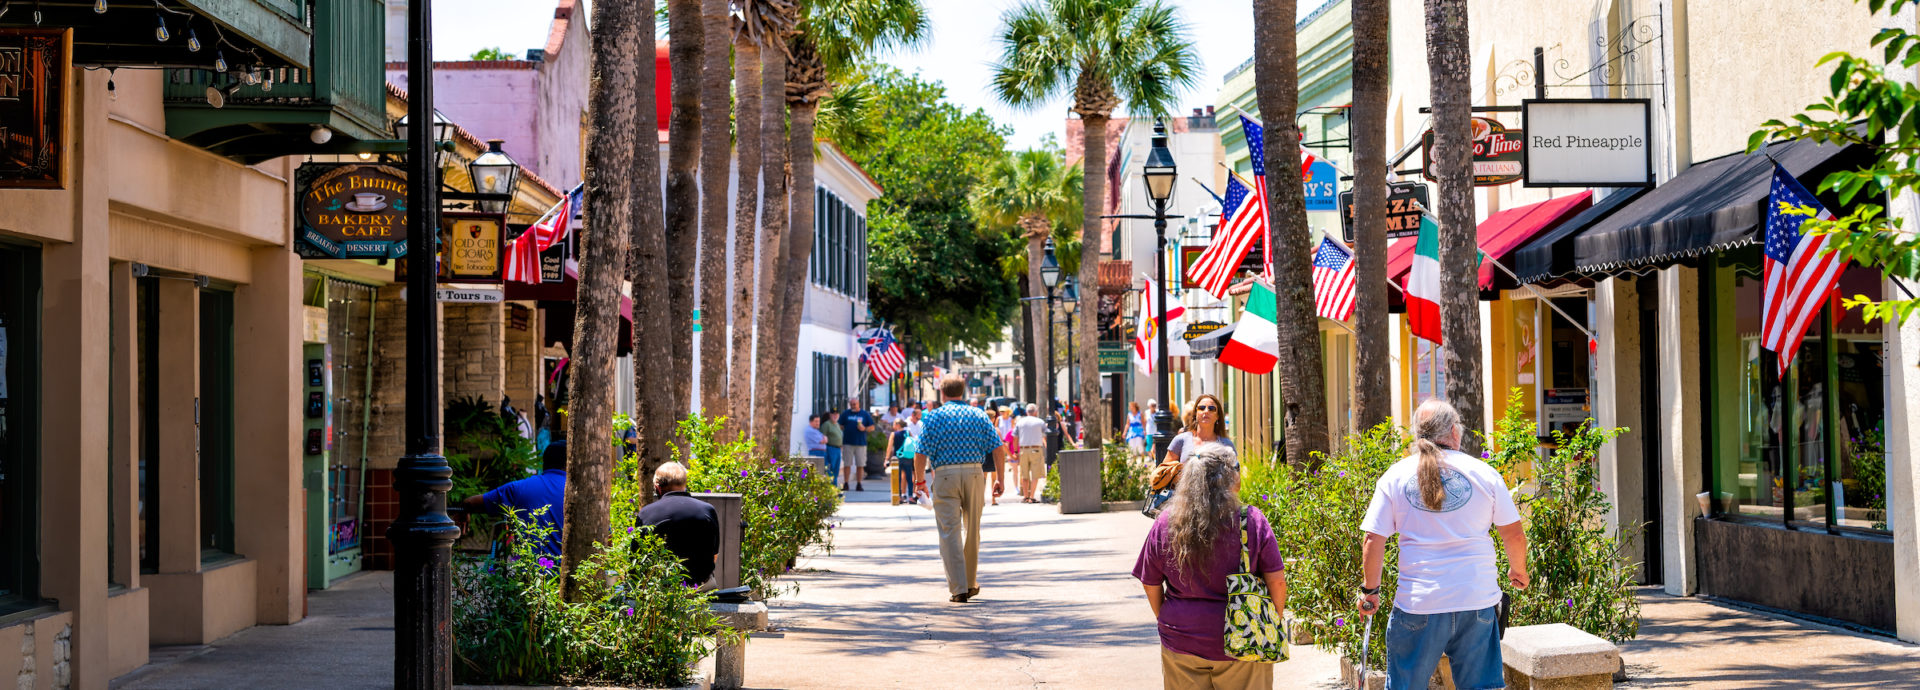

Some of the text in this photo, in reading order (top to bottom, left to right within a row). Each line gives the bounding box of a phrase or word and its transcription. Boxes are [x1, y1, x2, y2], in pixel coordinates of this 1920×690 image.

[1484, 133, 1522, 157] Time
[1532, 135, 1643, 151] Red Pineapple
[1480, 164, 1516, 173] ITALIANA
[310, 175, 408, 204] The Bunne
[318, 214, 396, 225] BAKERY
[1386, 213, 1421, 231] ME
[341, 225, 393, 237] CAFE
[305, 230, 341, 255] BREAKFAST
[346, 243, 388, 252] DESSERT
[454, 238, 495, 249] OLD CITY
[456, 248, 494, 261] CIGARS
[466, 263, 495, 271] Tobacco
[542, 263, 560, 273] Stuff
[445, 290, 480, 300] Tours
